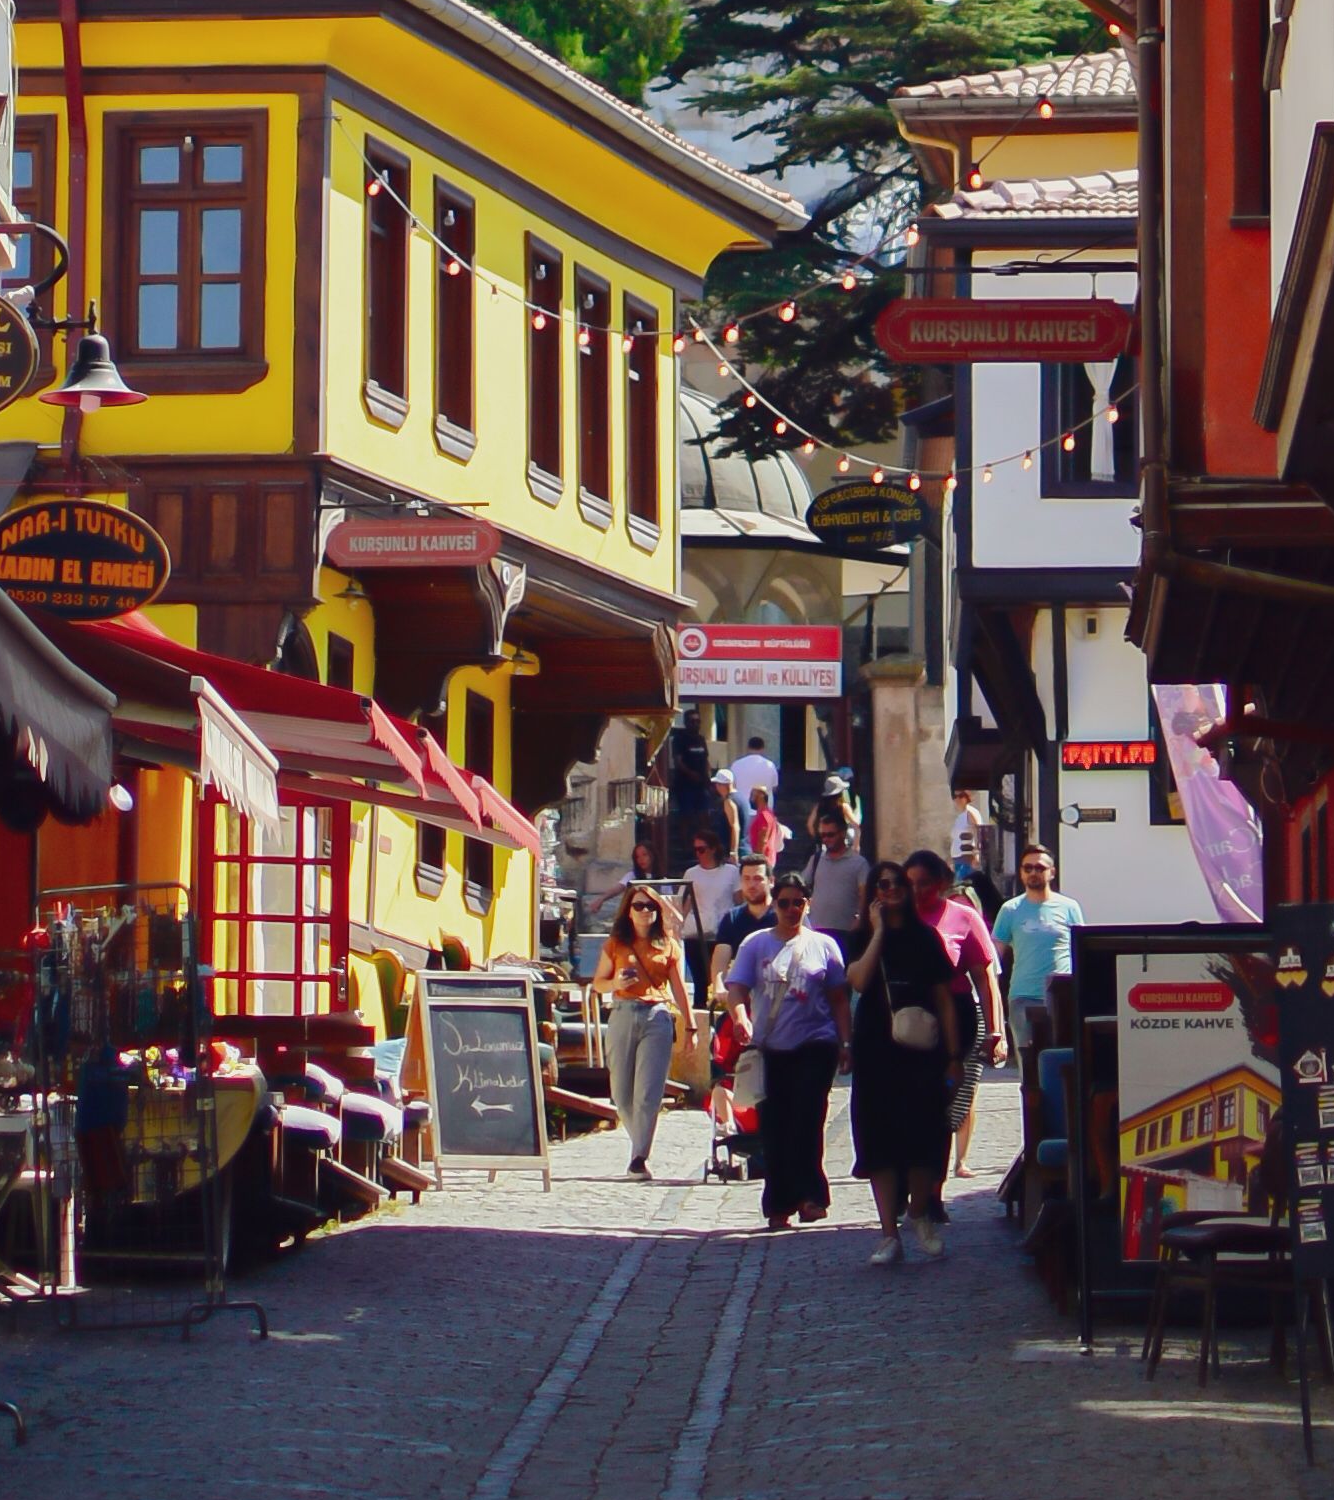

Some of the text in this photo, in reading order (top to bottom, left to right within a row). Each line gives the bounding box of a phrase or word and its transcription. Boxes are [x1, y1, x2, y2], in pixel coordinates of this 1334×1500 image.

[910, 314, 1096, 347] KURŞUNLU KAHVESİ
[883, 510, 891, 523] &
[74, 508, 145, 553] TUTKU
[350, 532, 477, 555] KURŞUNLU KAHVESİ
[62, 560, 83, 584] EL
[91, 560, 155, 589] EMEĞİ
[677, 666, 727, 689] URŞUNLU
[767, 672, 778, 686] ve
[781, 664, 836, 686] KÜLLİYESİ
[1130, 1016, 1234, 1029] KÖZDE KAHVE
